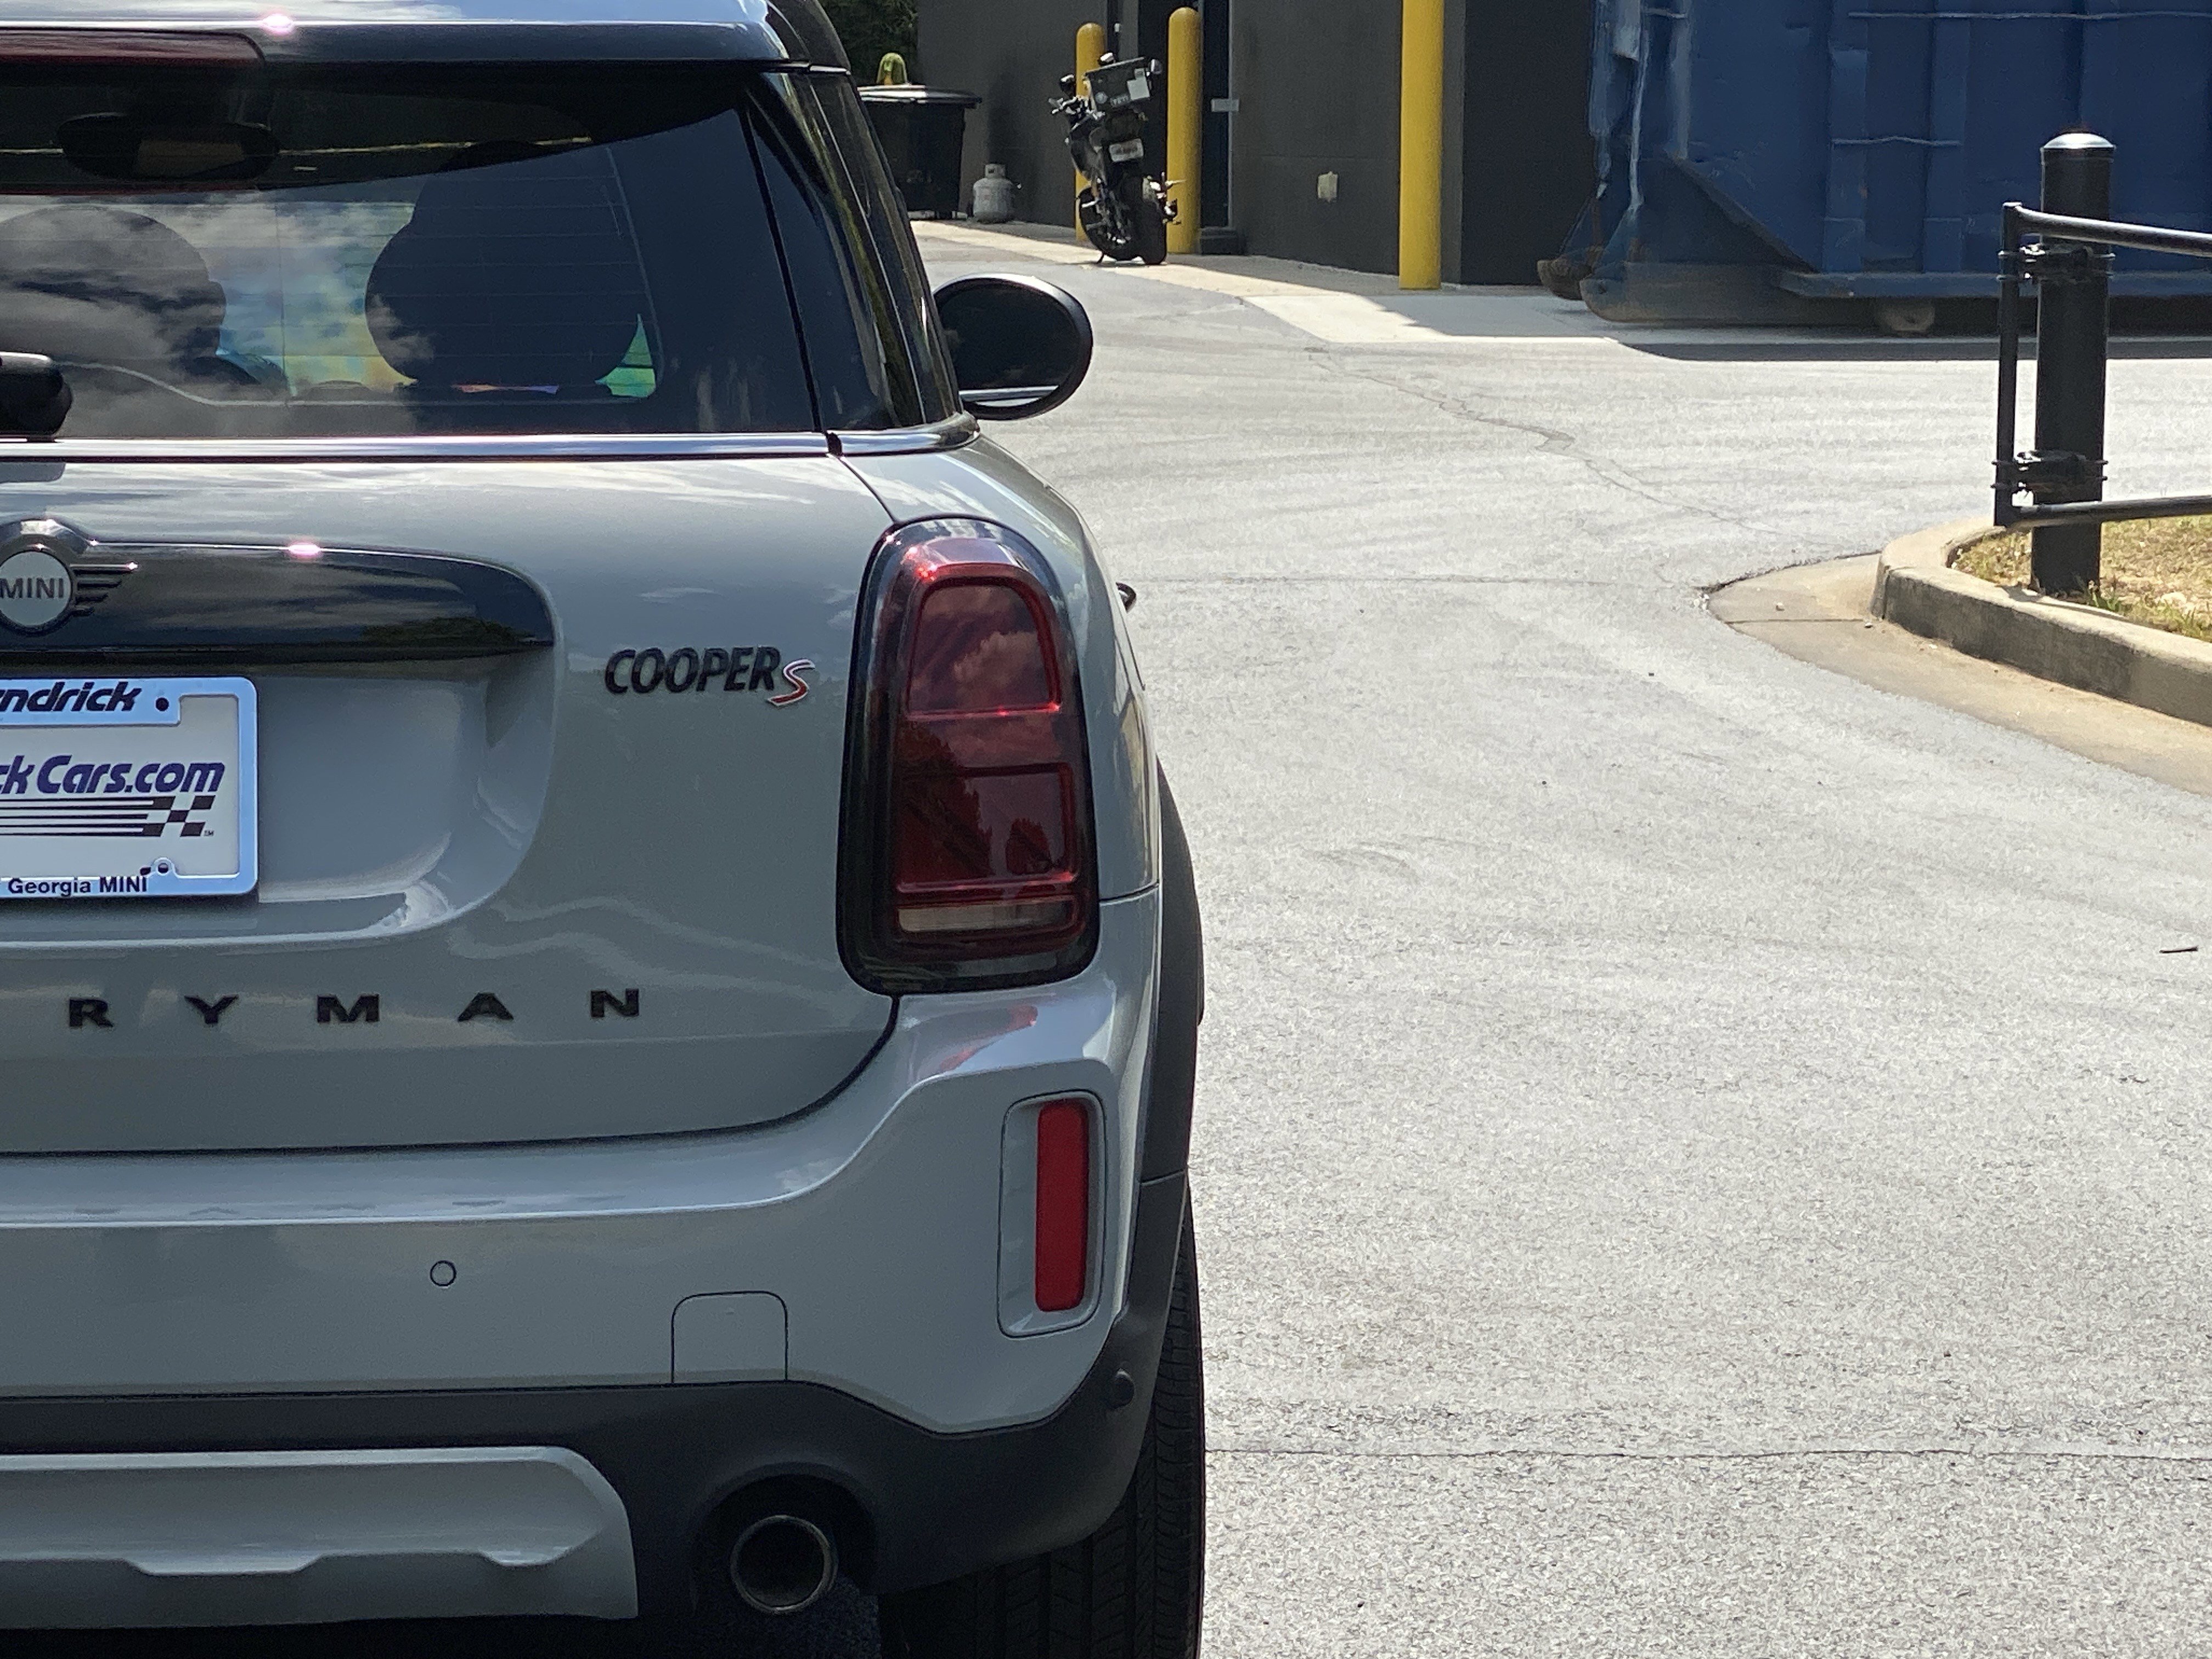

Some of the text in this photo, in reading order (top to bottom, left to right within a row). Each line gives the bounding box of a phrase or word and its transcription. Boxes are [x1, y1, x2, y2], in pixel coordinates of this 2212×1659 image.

[0, 578, 64, 600] MINI
[604, 646, 781, 694] COOPER
[0, 682, 142, 712] ndrick
[8, 876, 147, 897] Georgia MINI
